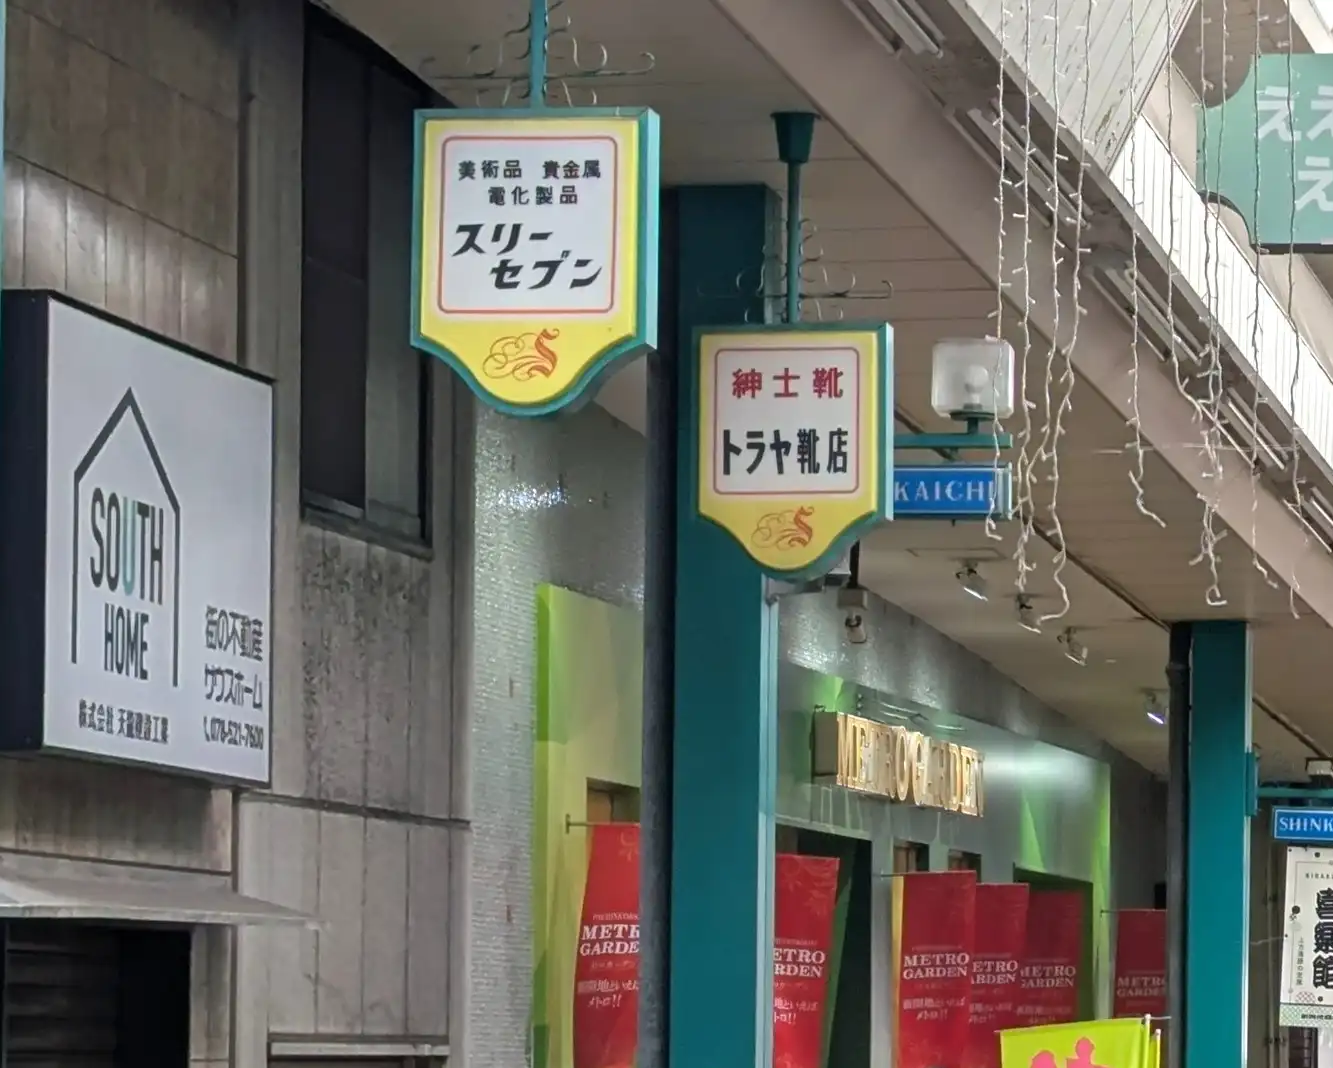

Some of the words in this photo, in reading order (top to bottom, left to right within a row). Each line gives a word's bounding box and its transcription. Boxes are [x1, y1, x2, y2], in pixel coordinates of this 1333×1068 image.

[458, 161, 522, 180] 美術品
[543, 160, 601, 180] 貴金属
[488, 186, 579, 206] 電化製品
[452, 223, 553, 256] スリー
[489, 248, 602, 290] セブン
[733, 368, 844, 399] 紳士靴
[722, 428, 849, 475] トラヤ靴店
[893, 481, 994, 502] KAICHI
[89, 487, 165, 606] SOUTH
[104, 603, 149, 680] HOME
[580, 941, 640, 956] GARDE
[773, 948, 826, 965] ETRO
[774, 963, 823, 978] RDEN
[903, 953, 970, 968] METRO
[972, 960, 1018, 974] ETRO
[903, 967, 968, 980] GARDEN
[971, 973, 1016, 986] ARDEN
[1117, 985, 1166, 998] GARDE
